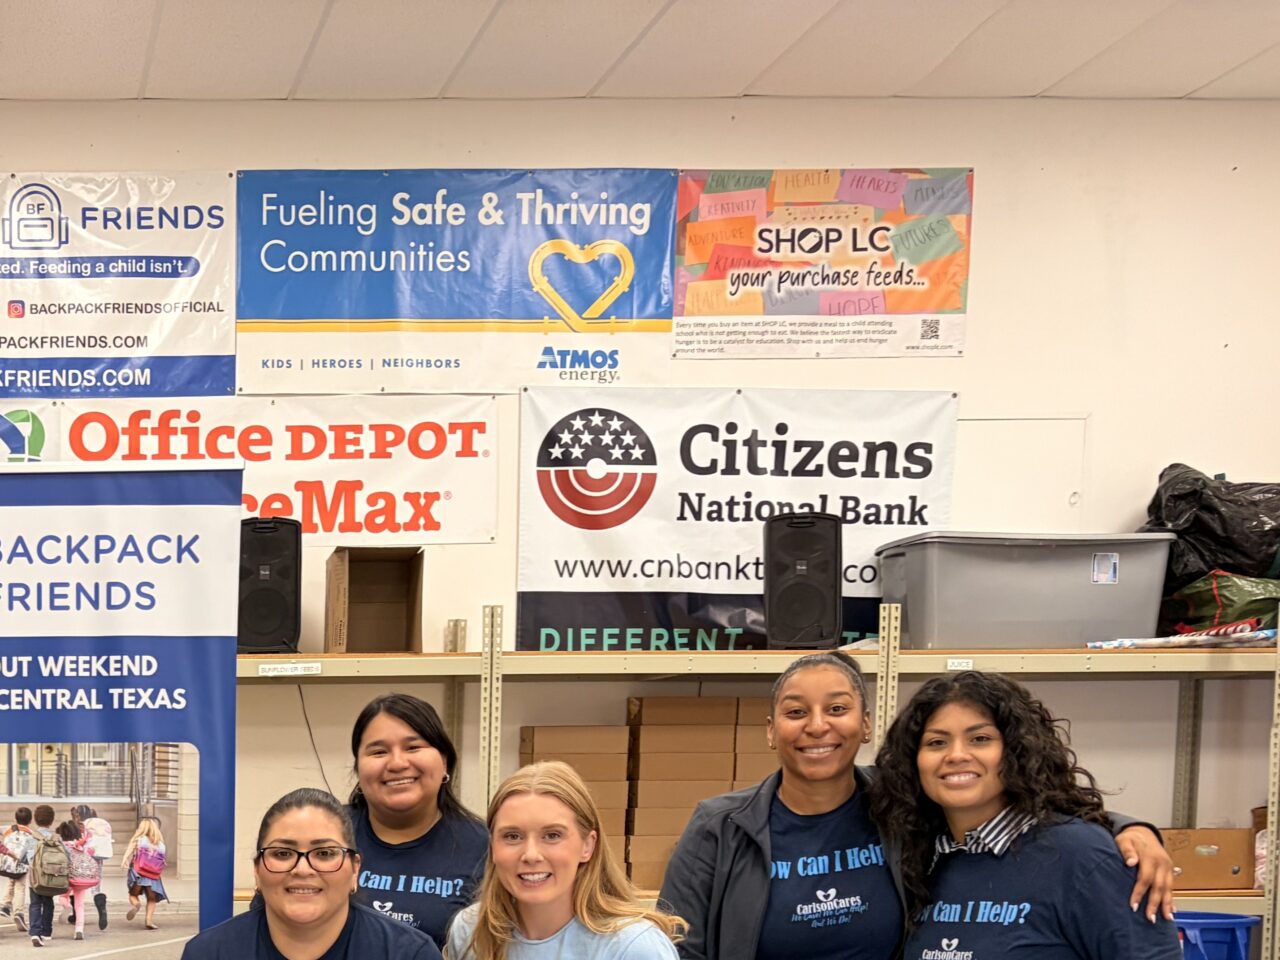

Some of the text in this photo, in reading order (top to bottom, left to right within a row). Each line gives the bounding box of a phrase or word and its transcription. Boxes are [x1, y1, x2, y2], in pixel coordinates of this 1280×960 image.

[26, 202, 46, 215] BF
[81, 205, 225, 231] FRIENDS
[261, 188, 651, 236] Fueling Safe & Thriving
[757, 227, 891, 254] SHOP LC
[29, 260, 91, 277] Feeding
[95, 263, 105, 275] a
[108, 259, 146, 275] child
[260, 239, 470, 273] Communities
[729, 262, 926, 296] your purchase feeds...
[29, 302, 224, 315] BACKPACKFRIENDSOFFICIAL
[261, 358, 461, 369] KIDS HEROES NEIGHBORS
[537, 346, 619, 369] ATMOS
[68, 409, 273, 462] Office
[679, 421, 934, 480] Citizens
[839, 495, 928, 525] Bank
[38, 655, 158, 677] WEEKEND
[109, 687, 187, 710] TEXAS
[797, 855, 829, 877] Can
[834, 850, 842, 872] I
[359, 870, 464, 898] Can I Help?
[797, 895, 862, 915] CarlsonCares
[933, 900, 962, 922] Can
[964, 901, 975, 922] I
[976, 901, 1031, 926] Help?
[922, 949, 974, 960] CarlsonCares
